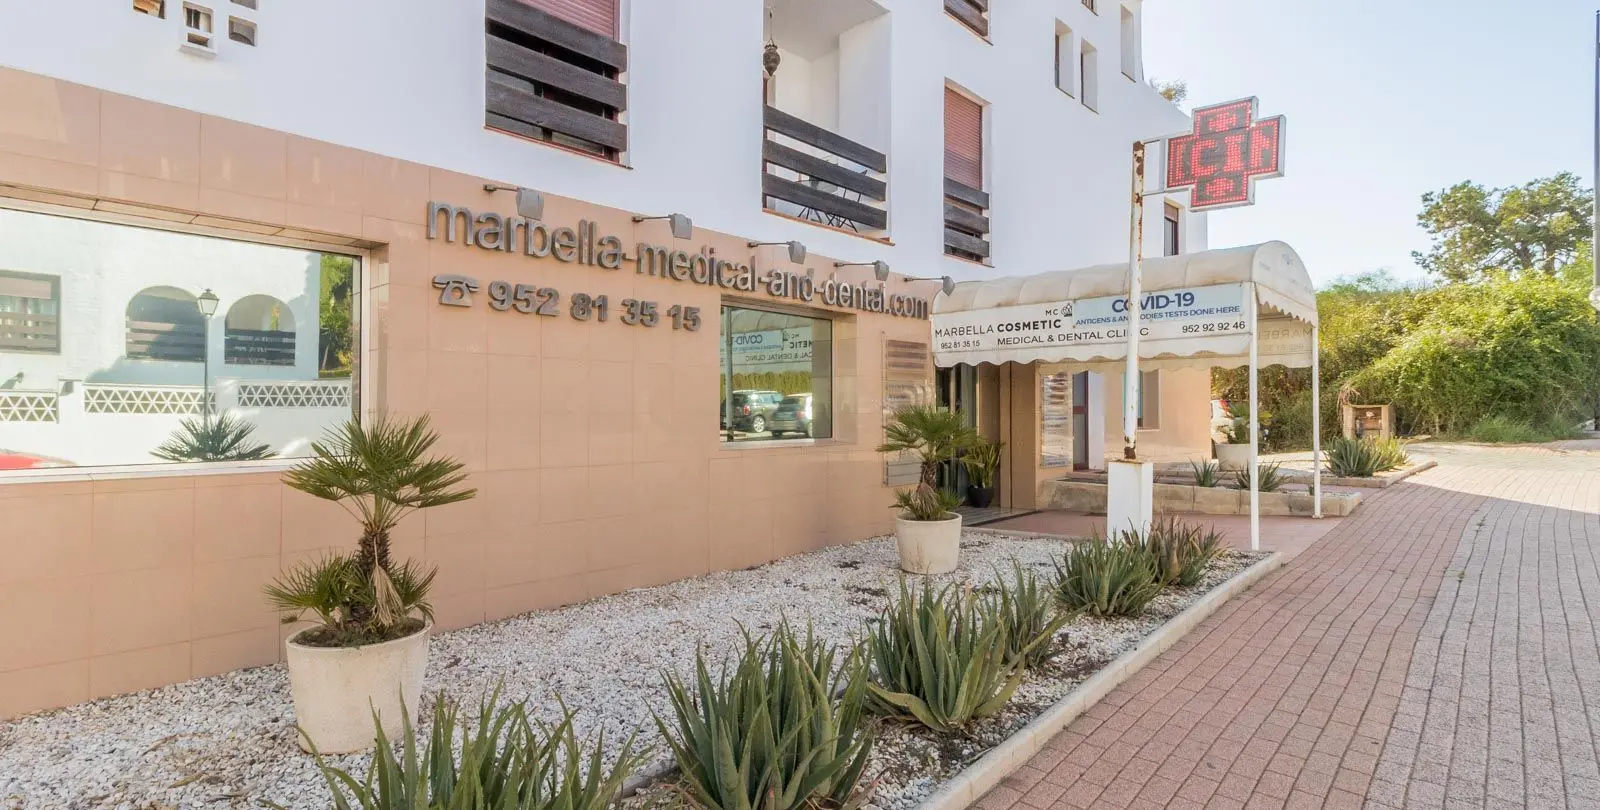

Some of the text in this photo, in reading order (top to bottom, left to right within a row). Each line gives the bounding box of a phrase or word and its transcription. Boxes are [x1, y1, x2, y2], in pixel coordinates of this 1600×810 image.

[488, 280, 702, 332] 952 81 35 15
[1075, 305, 1241, 326] ANTIGENS & ANODIES TESTS DONE HERE
[935, 319, 1062, 337] MARBELLA COSMETIC
[1181, 320, 1246, 334] 952 92 92 46
[940, 341, 952, 350] 952
[953, 341, 961, 349] 81
[997, 327, 1150, 346] MEDICAL & DENTAL CLIC
